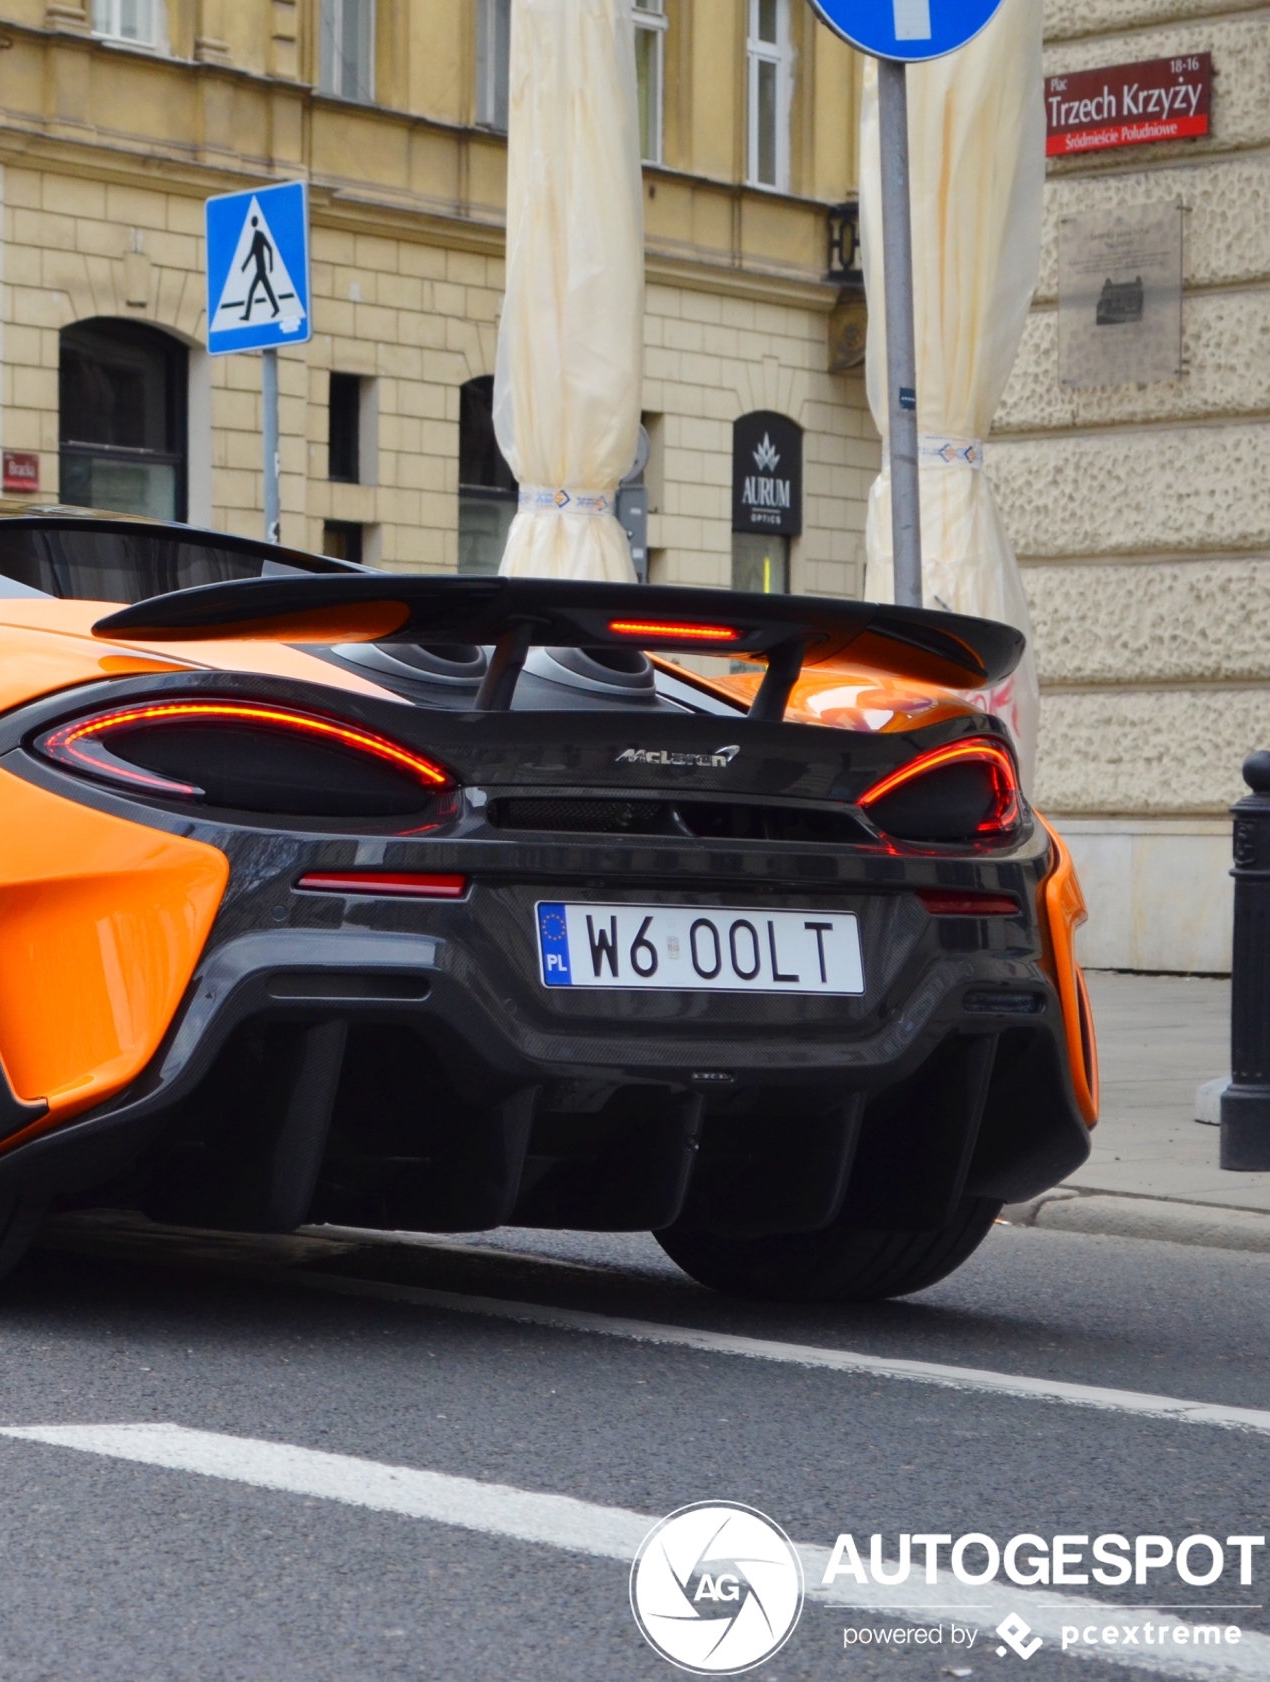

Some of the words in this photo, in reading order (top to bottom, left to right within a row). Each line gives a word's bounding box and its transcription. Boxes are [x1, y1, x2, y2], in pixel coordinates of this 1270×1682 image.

[1170, 56, 1199, 74] 18-16
[1050, 78, 1067, 92] Plac
[1048, 85, 1117, 127] Trzech
[1122, 75, 1202, 120] Krzyży
[1065, 131, 1118, 150] Śródmieście
[1121, 122, 1177, 141] Południowe
[742, 475, 790, 508] AURUM
[751, 513, 781, 525] OPTICS
[615, 748, 727, 768] McLaren
[585, 914, 658, 978] W6
[547, 953, 567, 972] PL
